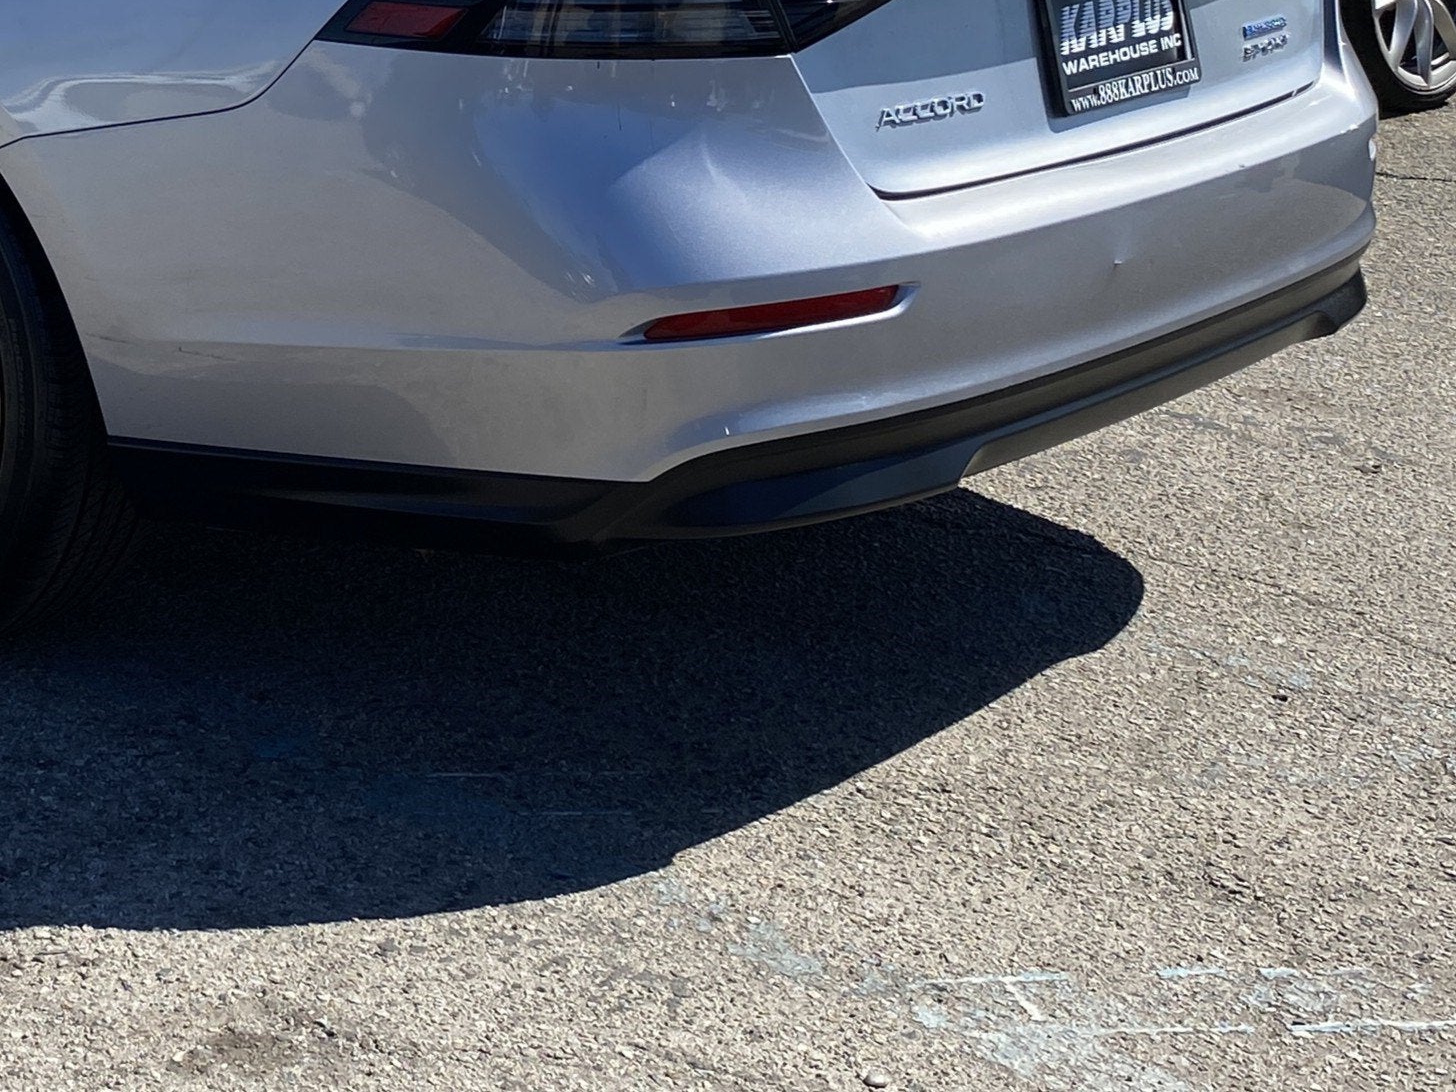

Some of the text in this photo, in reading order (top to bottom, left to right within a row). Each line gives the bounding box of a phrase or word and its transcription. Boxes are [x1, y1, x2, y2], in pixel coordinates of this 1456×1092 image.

[1062, 33, 1182, 76] WAREHOUSE INC
[875, 91, 986, 132] ACCORD
